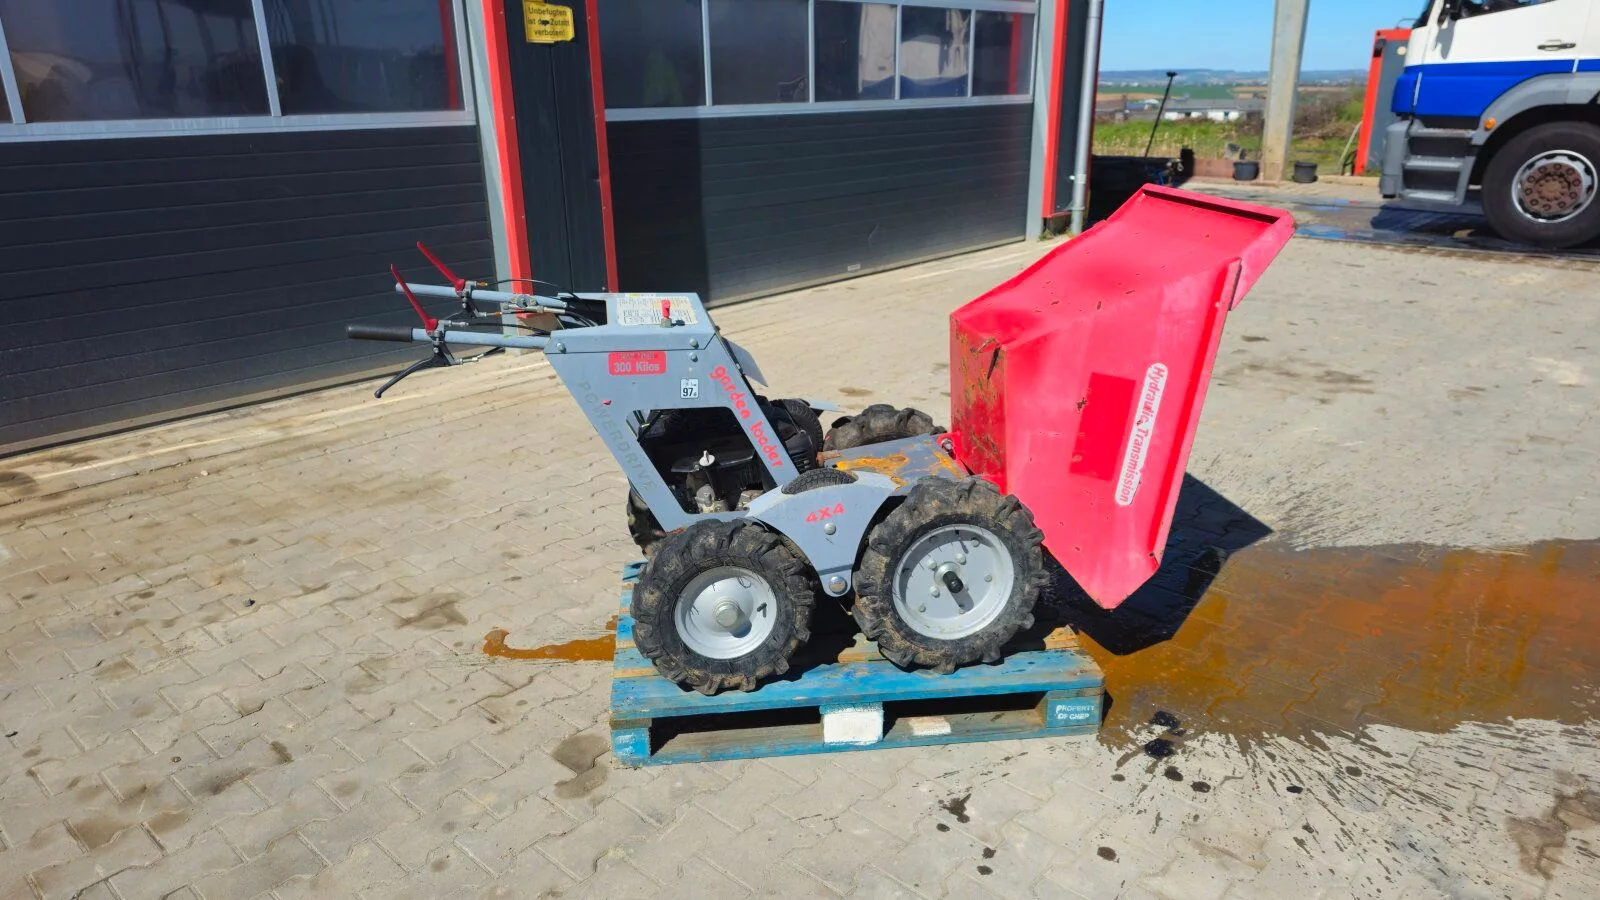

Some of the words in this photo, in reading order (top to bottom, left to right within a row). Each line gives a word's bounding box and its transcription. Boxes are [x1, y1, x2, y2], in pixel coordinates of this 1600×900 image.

[528, 6, 567, 17] Unbefugten
[614, 362, 632, 372] 300
[635, 360, 660, 372] Kilos
[682, 387, 694, 397] 97
[1141, 366, 1166, 424] Hydraulic
[575, 381, 658, 491] POWERDRIVE
[708, 364, 752, 420] garden
[749, 420, 784, 468] loader
[1119, 428, 1150, 503] Transmission
